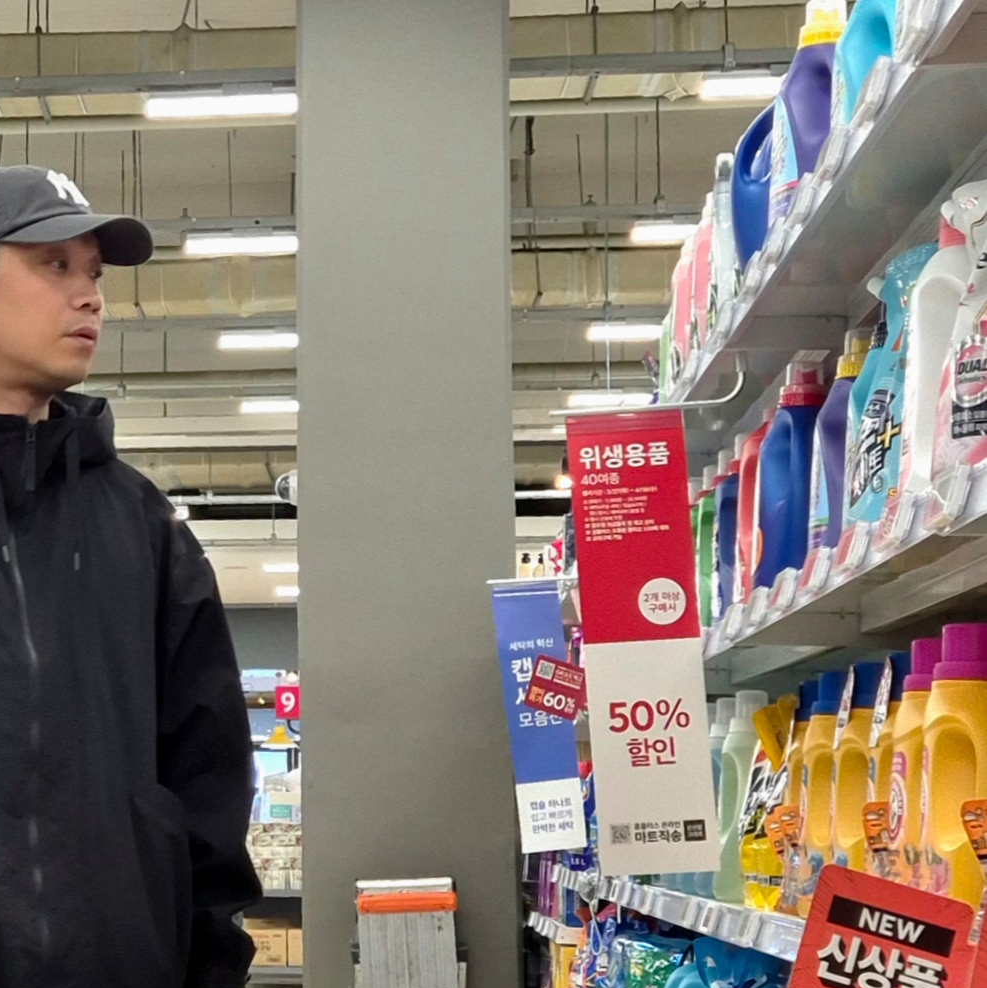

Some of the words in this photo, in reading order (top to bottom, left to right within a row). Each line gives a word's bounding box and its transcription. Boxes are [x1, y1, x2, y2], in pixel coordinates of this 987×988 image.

[579, 441, 670, 470] 위생용품
[581, 472, 620, 486] 40여종
[644, 591, 660, 602] 2개
[662, 591, 680, 601] 이상
[649, 602, 677, 614] 구매시
[280, 690, 297, 713] 9
[543, 691, 576, 711] 60%
[609, 698, 691, 733] 50%
[626, 736, 676, 767] 할인
[634, 829, 682, 844] 마트직송
[858, 907, 925, 944] NEW
